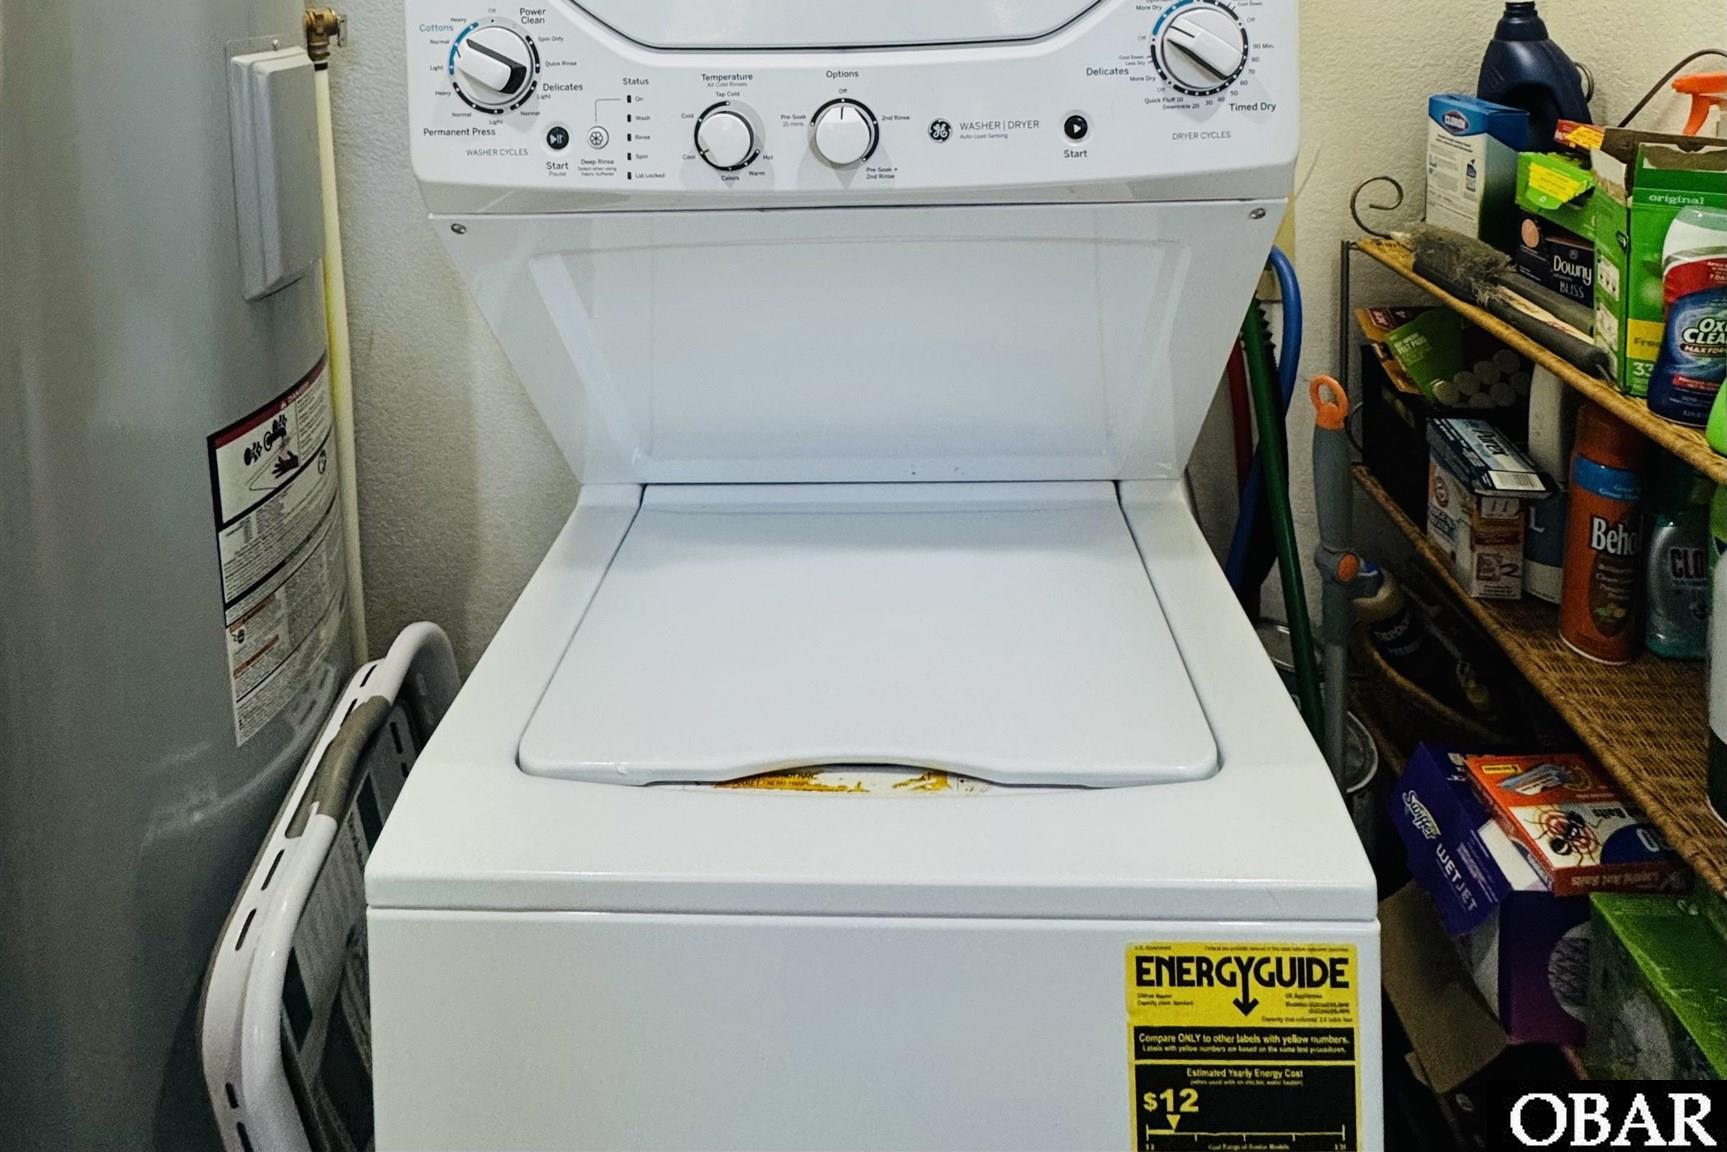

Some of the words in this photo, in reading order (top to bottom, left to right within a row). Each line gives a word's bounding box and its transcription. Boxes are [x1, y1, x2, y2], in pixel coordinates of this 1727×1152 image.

[520, 8, 546, 16] Power
[521, 16, 545, 24] Clean
[419, 24, 454, 32] Cottons
[826, 70, 859, 79] Options
[1086, 67, 1129, 76] Delicates
[701, 73, 753, 82] Temperature
[542, 83, 583, 91] Delicates
[1229, 103, 1258, 111] Timed
[1260, 102, 1277, 112] Dry
[960, 121, 1001, 130] WASHER
[1007, 119, 1040, 129] DRYER
[423, 128, 470, 136] Permanent
[472, 128, 496, 136] Press
[1172, 132, 1199, 140] DRYER
[1200, 131, 1232, 139] CYCLES
[499, 148, 529, 156] CYCLES
[1063, 149, 1088, 158] Start
[546, 161, 569, 170] Start
[1648, 194, 1705, 205] original
[1552, 254, 1593, 286] Downy
[1559, 280, 1585, 299] BLISS
[1683, 327, 1727, 344] CLEA
[1135, 955, 1350, 989] ENERGYGUIDE
[1139, 1033, 1177, 1044] Compare
[1177, 1033, 1201, 1043] ONLY
[1202, 1034, 1211, 1043] to
[1212, 1034, 1235, 1043] other
[1236, 1033, 1261, 1043] labels
[1262, 1034, 1281, 1044] with
[1282, 1034, 1309, 1046] yellow
[1186, 1068, 1226, 1077] Estimated
[1228, 1068, 1253, 1079] Yearly
[1254, 1068, 1283, 1079] Energy
[1284, 1068, 1304, 1078] Cost
[1143, 1088, 1200, 1113] $12
